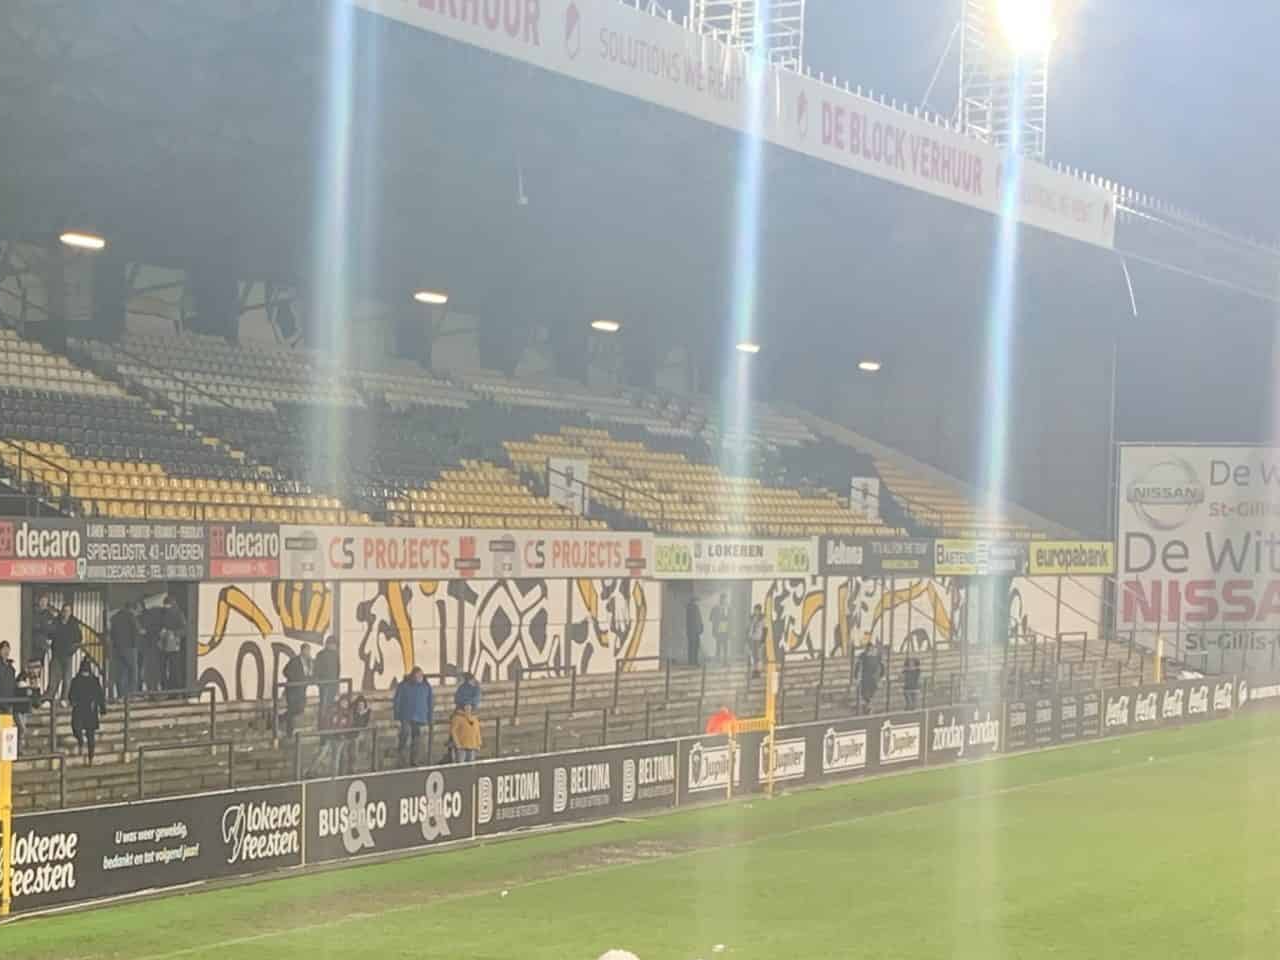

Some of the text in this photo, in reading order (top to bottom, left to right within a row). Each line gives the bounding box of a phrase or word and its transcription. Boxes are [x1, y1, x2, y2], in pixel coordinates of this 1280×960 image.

[822, 101, 983, 196] DE BLOCK VERHUUR
[1210, 460, 1250, 487] De
[1134, 486, 1198, 498] NISSAN
[15, 521, 80, 557] decaro
[226, 525, 279, 558] decaro
[363, 536, 450, 569] PROJECTS
[552, 539, 622, 569] PROJECTS
[1124, 531, 1189, 574] De
[1035, 543, 1109, 571] europabank
[570, 763, 610, 794] BELTONA
[638, 755, 674, 785] BELTONA
[497, 771, 540, 804] BELTONA
